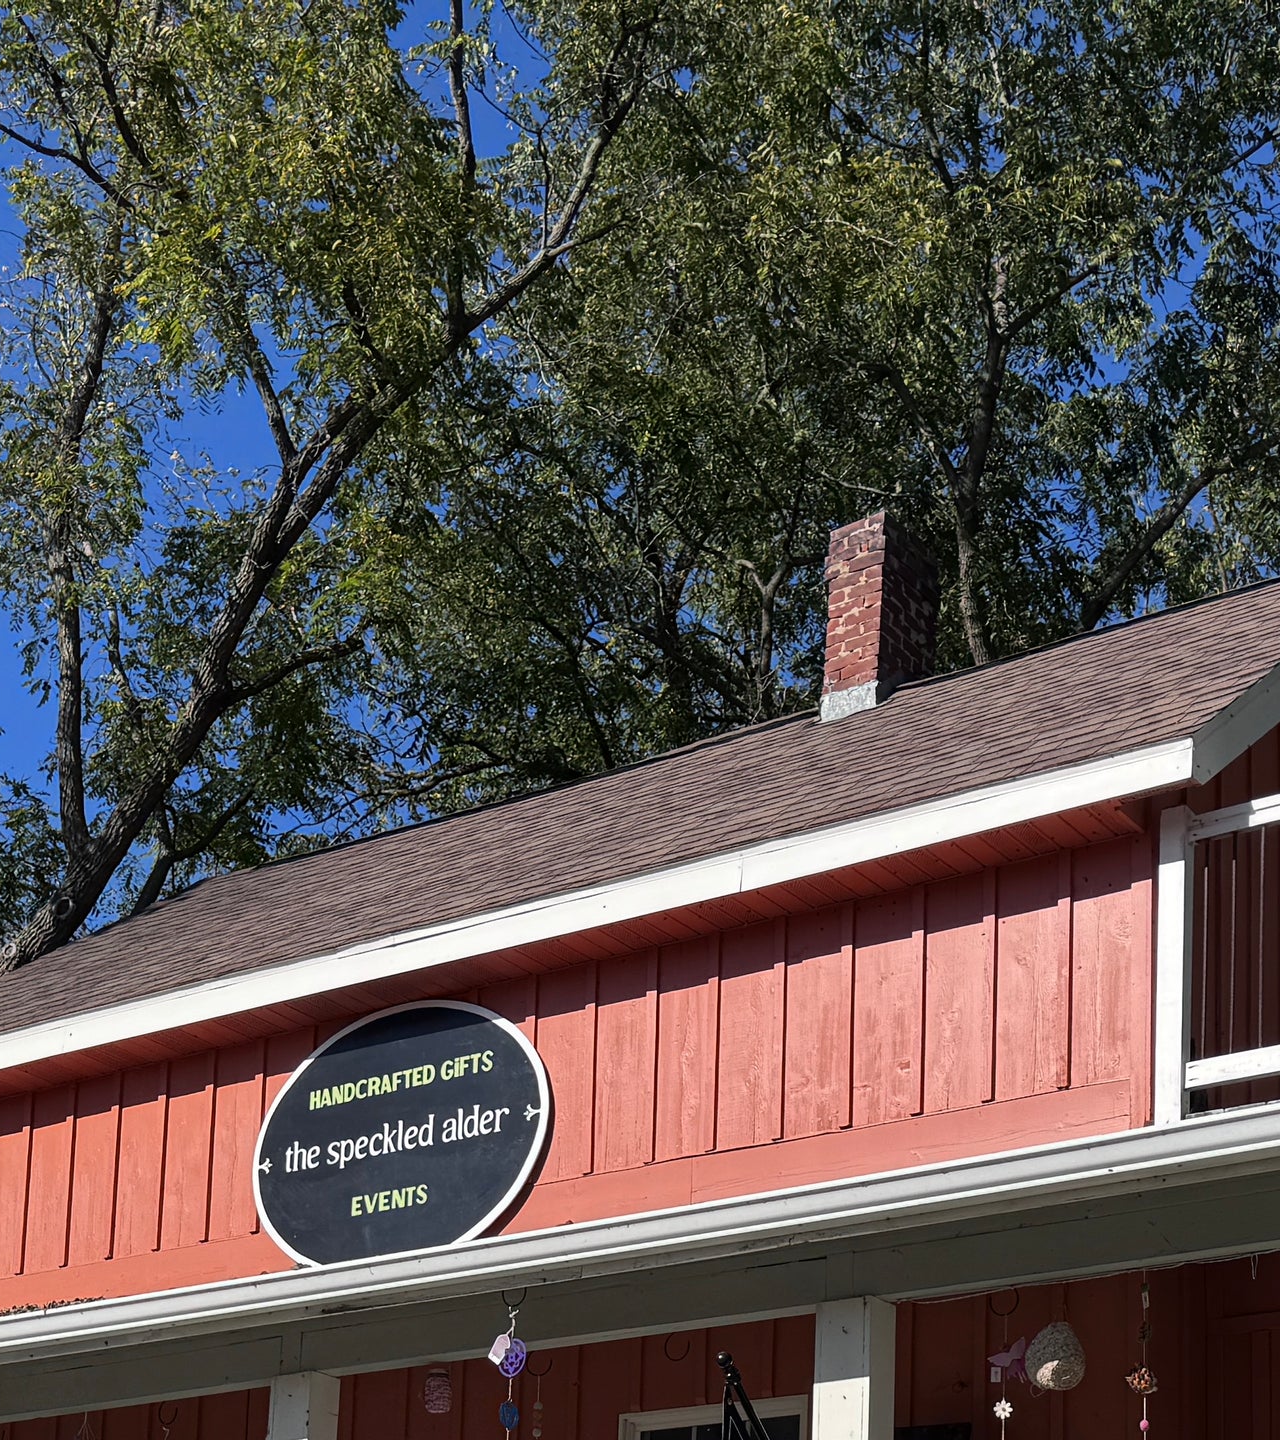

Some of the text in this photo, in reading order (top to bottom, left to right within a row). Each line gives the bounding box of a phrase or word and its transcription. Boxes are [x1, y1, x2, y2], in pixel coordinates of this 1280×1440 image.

[309, 1064, 436, 1111] HANDCRAFTED
[285, 1104, 510, 1173] the speckled alder
[350, 1183, 428, 1217] EVENTS
